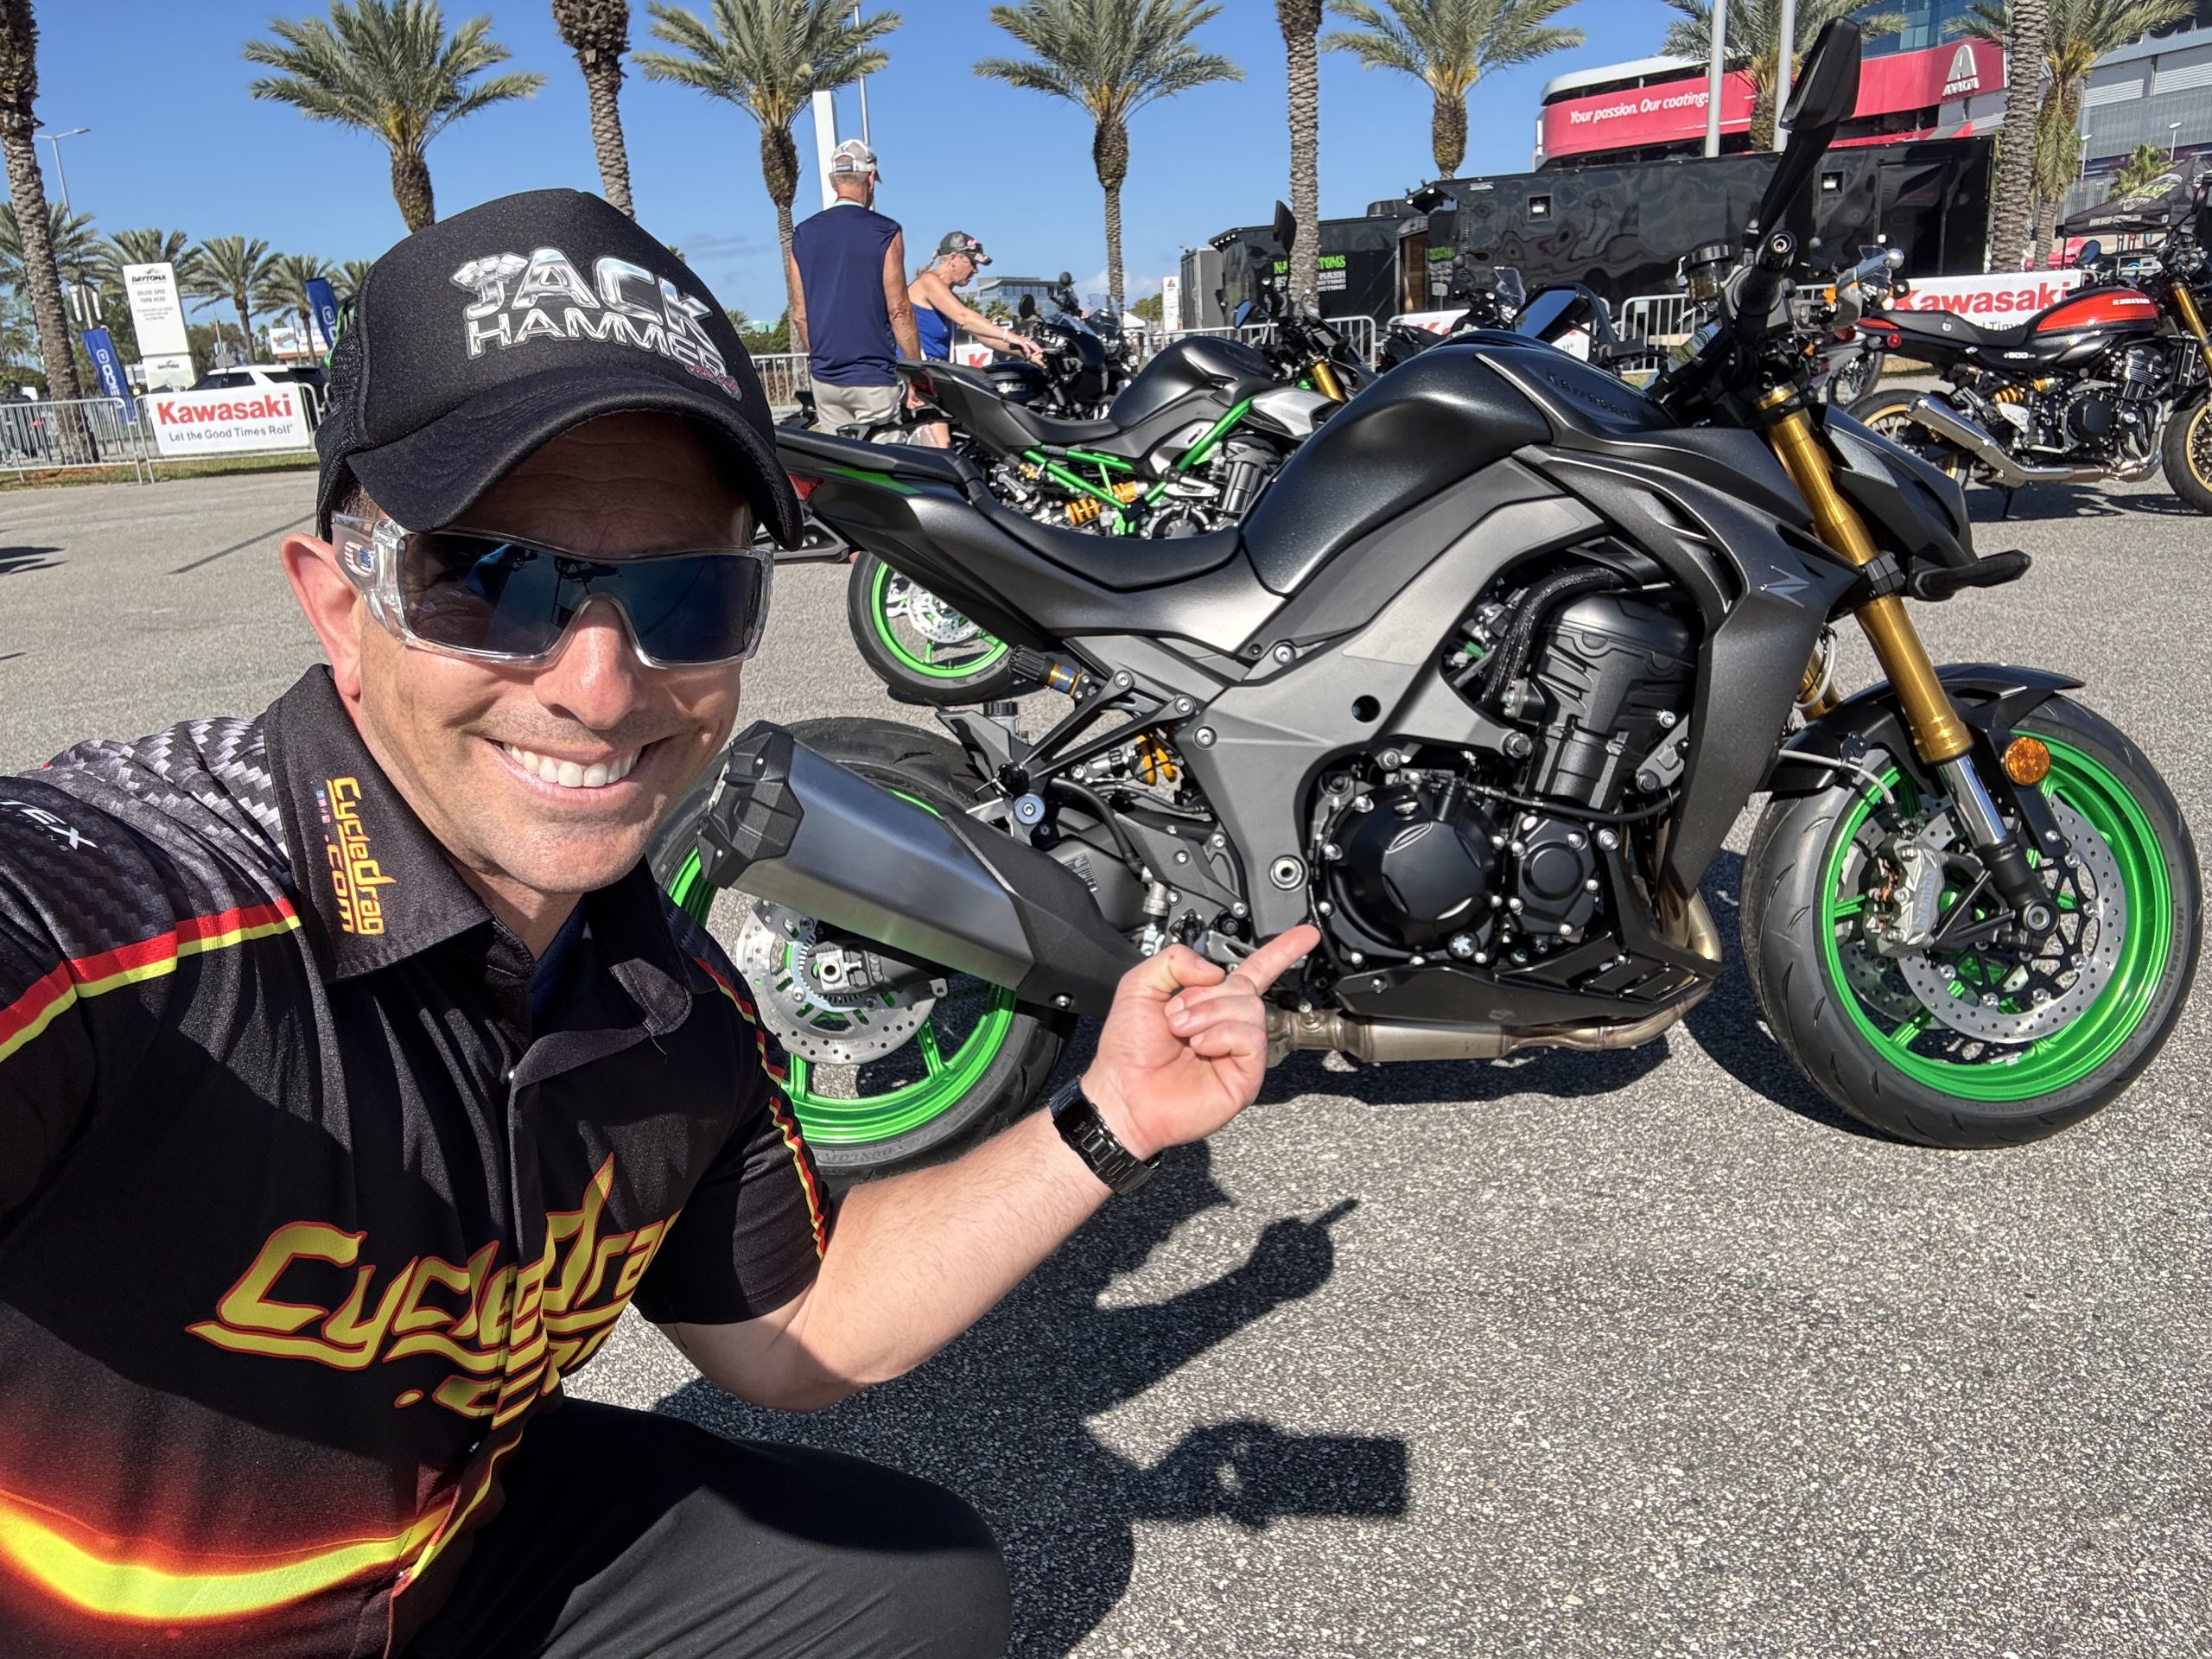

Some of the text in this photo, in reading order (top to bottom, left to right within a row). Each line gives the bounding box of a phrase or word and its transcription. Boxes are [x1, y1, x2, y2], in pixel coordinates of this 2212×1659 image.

[1570, 111, 1593, 124] Your
[1593, 103, 1638, 124] passion.
[1641, 99, 1662, 113] Our
[449, 246, 712, 336] JACK
[467, 307, 727, 378] HAMMER
[156, 393, 293, 425] Kawasaki
[169, 432, 184, 442] Let
[187, 430, 203, 441] the
[205, 428, 232, 440] Good
[234, 426, 267, 437] Times
